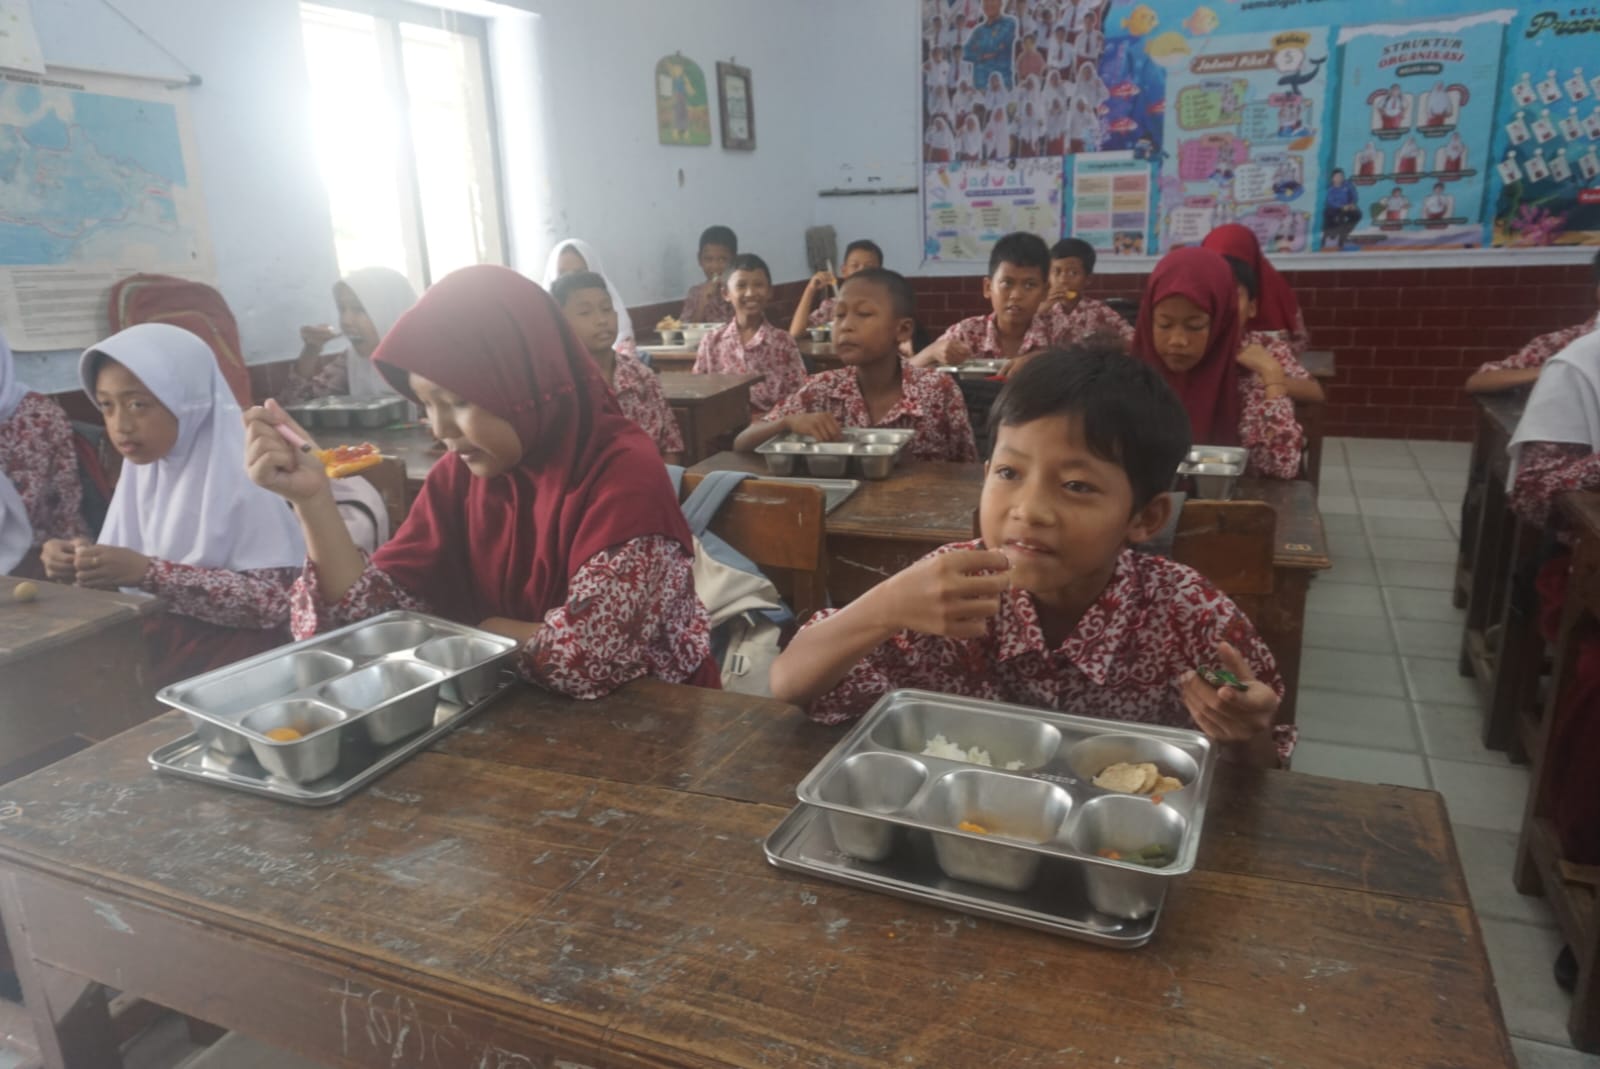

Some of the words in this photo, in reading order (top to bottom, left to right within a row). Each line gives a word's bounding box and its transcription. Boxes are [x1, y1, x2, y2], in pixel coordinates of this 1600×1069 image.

[1383, 37, 1463, 56] STRUKTUR
[1195, 55, 1239, 72] Jadwal
[1377, 50, 1466, 69] ORGANISASI
[958, 168, 1025, 191] jadwal
